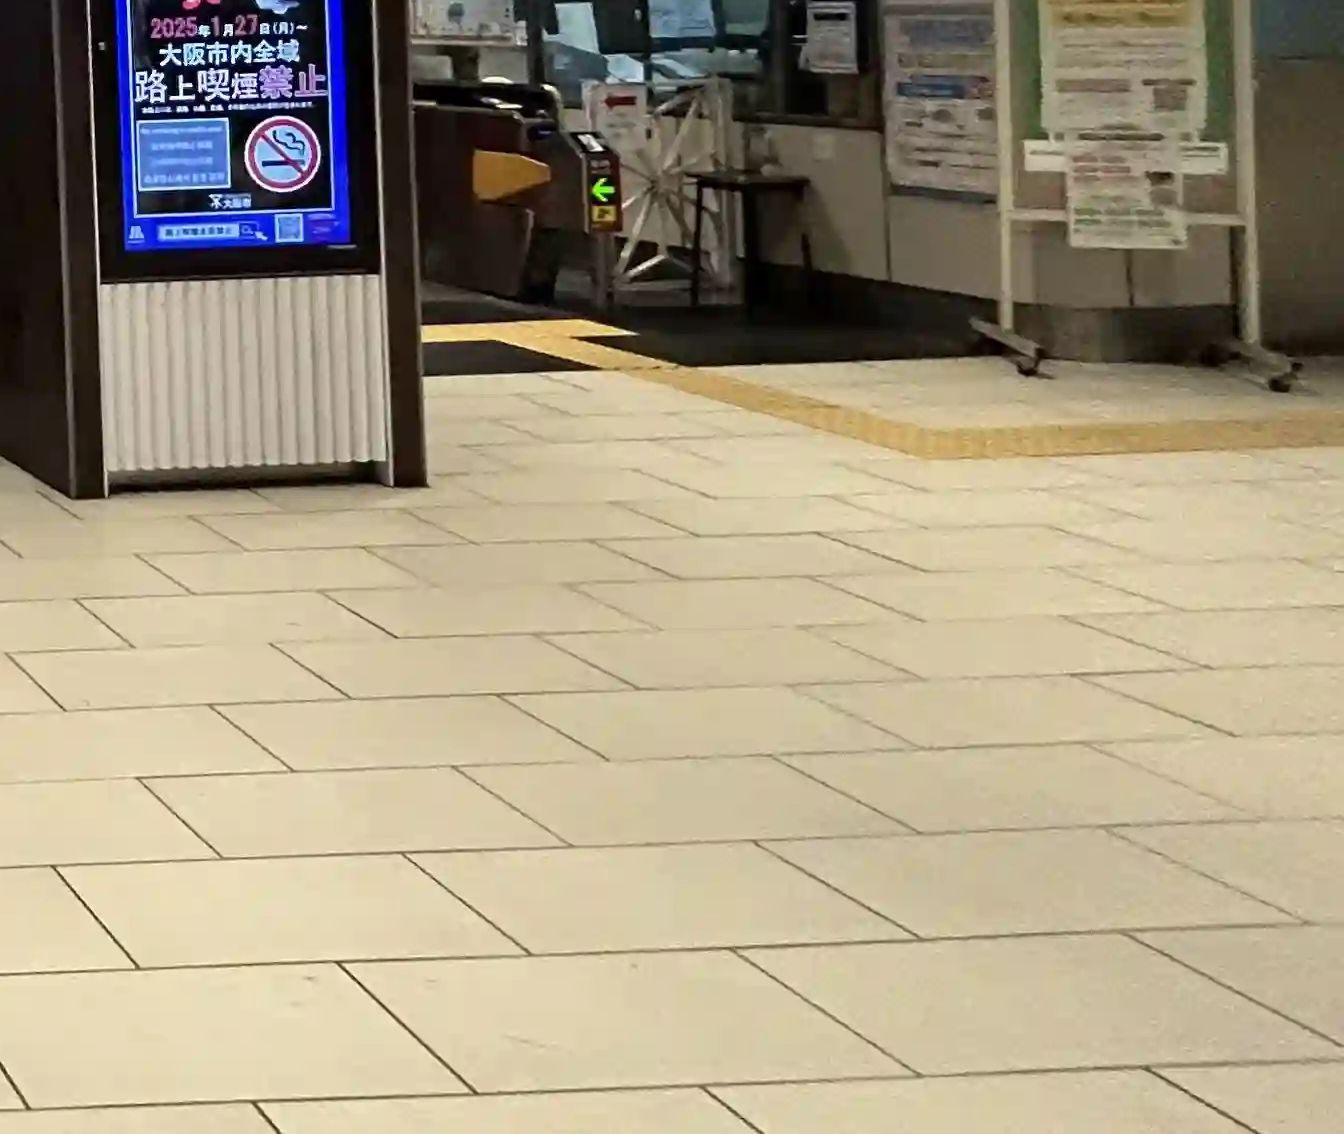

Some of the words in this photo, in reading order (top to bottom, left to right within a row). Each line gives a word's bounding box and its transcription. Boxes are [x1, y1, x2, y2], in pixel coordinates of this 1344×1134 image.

[159, 39, 301, 67] 大阪市内全域
[135, 64, 328, 104] 路上喫煙禁止
